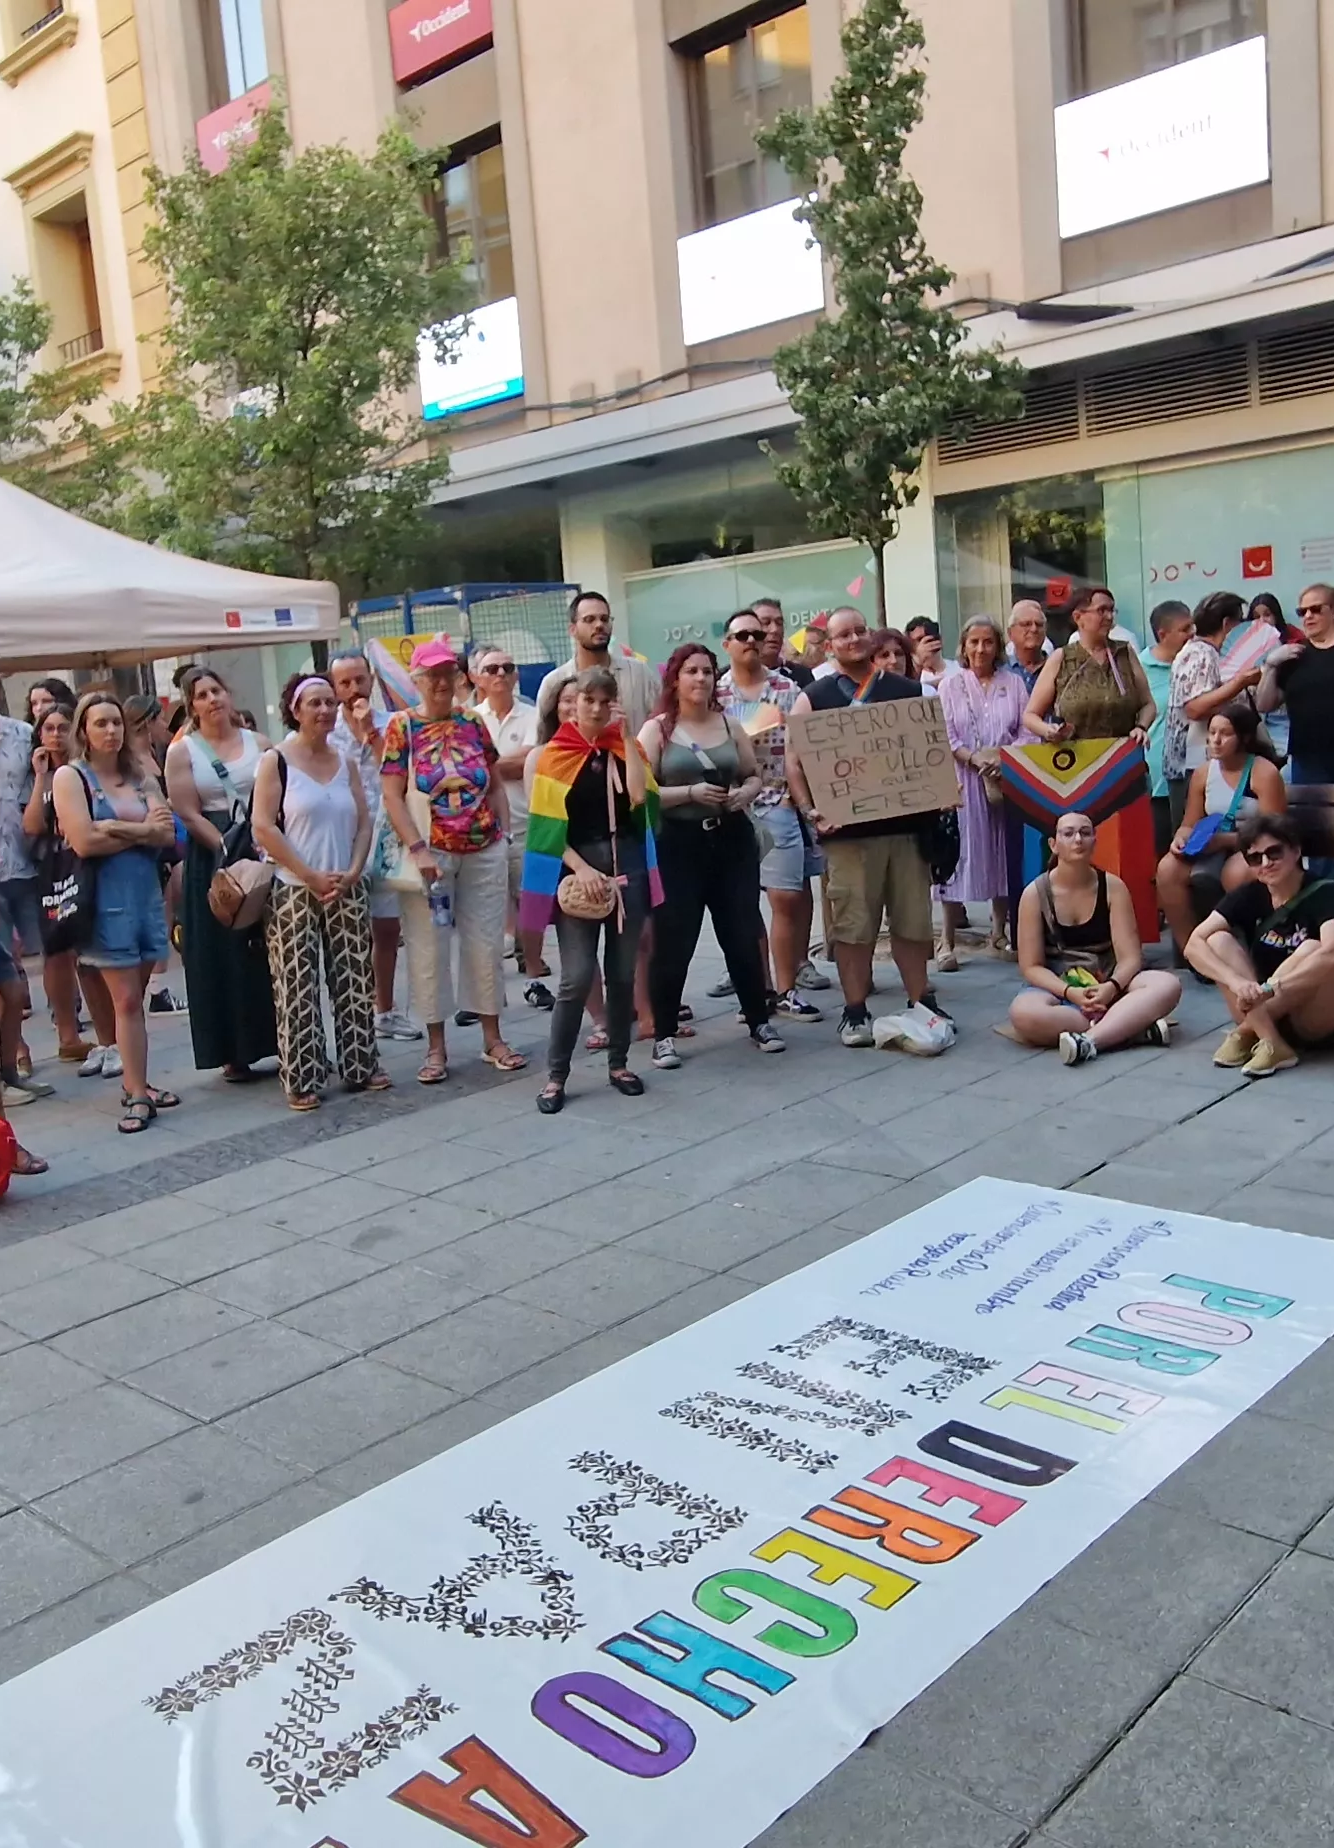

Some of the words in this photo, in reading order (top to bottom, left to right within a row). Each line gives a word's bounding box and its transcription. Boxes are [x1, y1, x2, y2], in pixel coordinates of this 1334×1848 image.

[421, 1, 471, 36] Occident
[804, 703, 898, 743] ESPERO
[908, 700, 944, 724] QUE
[924, 729, 949, 745] DE
[834, 747, 946, 778] ORULLO
[852, 784, 938, 815] EES
[1066, 1272, 1296, 1377] POR
[661, 1314, 1003, 1474] EN
[980, 1361, 1165, 1435] EL
[141, 1448, 748, 1813] PAZ
[530, 1419, 1078, 1779] DERECHO
[387, 1733, 590, 1848] A
